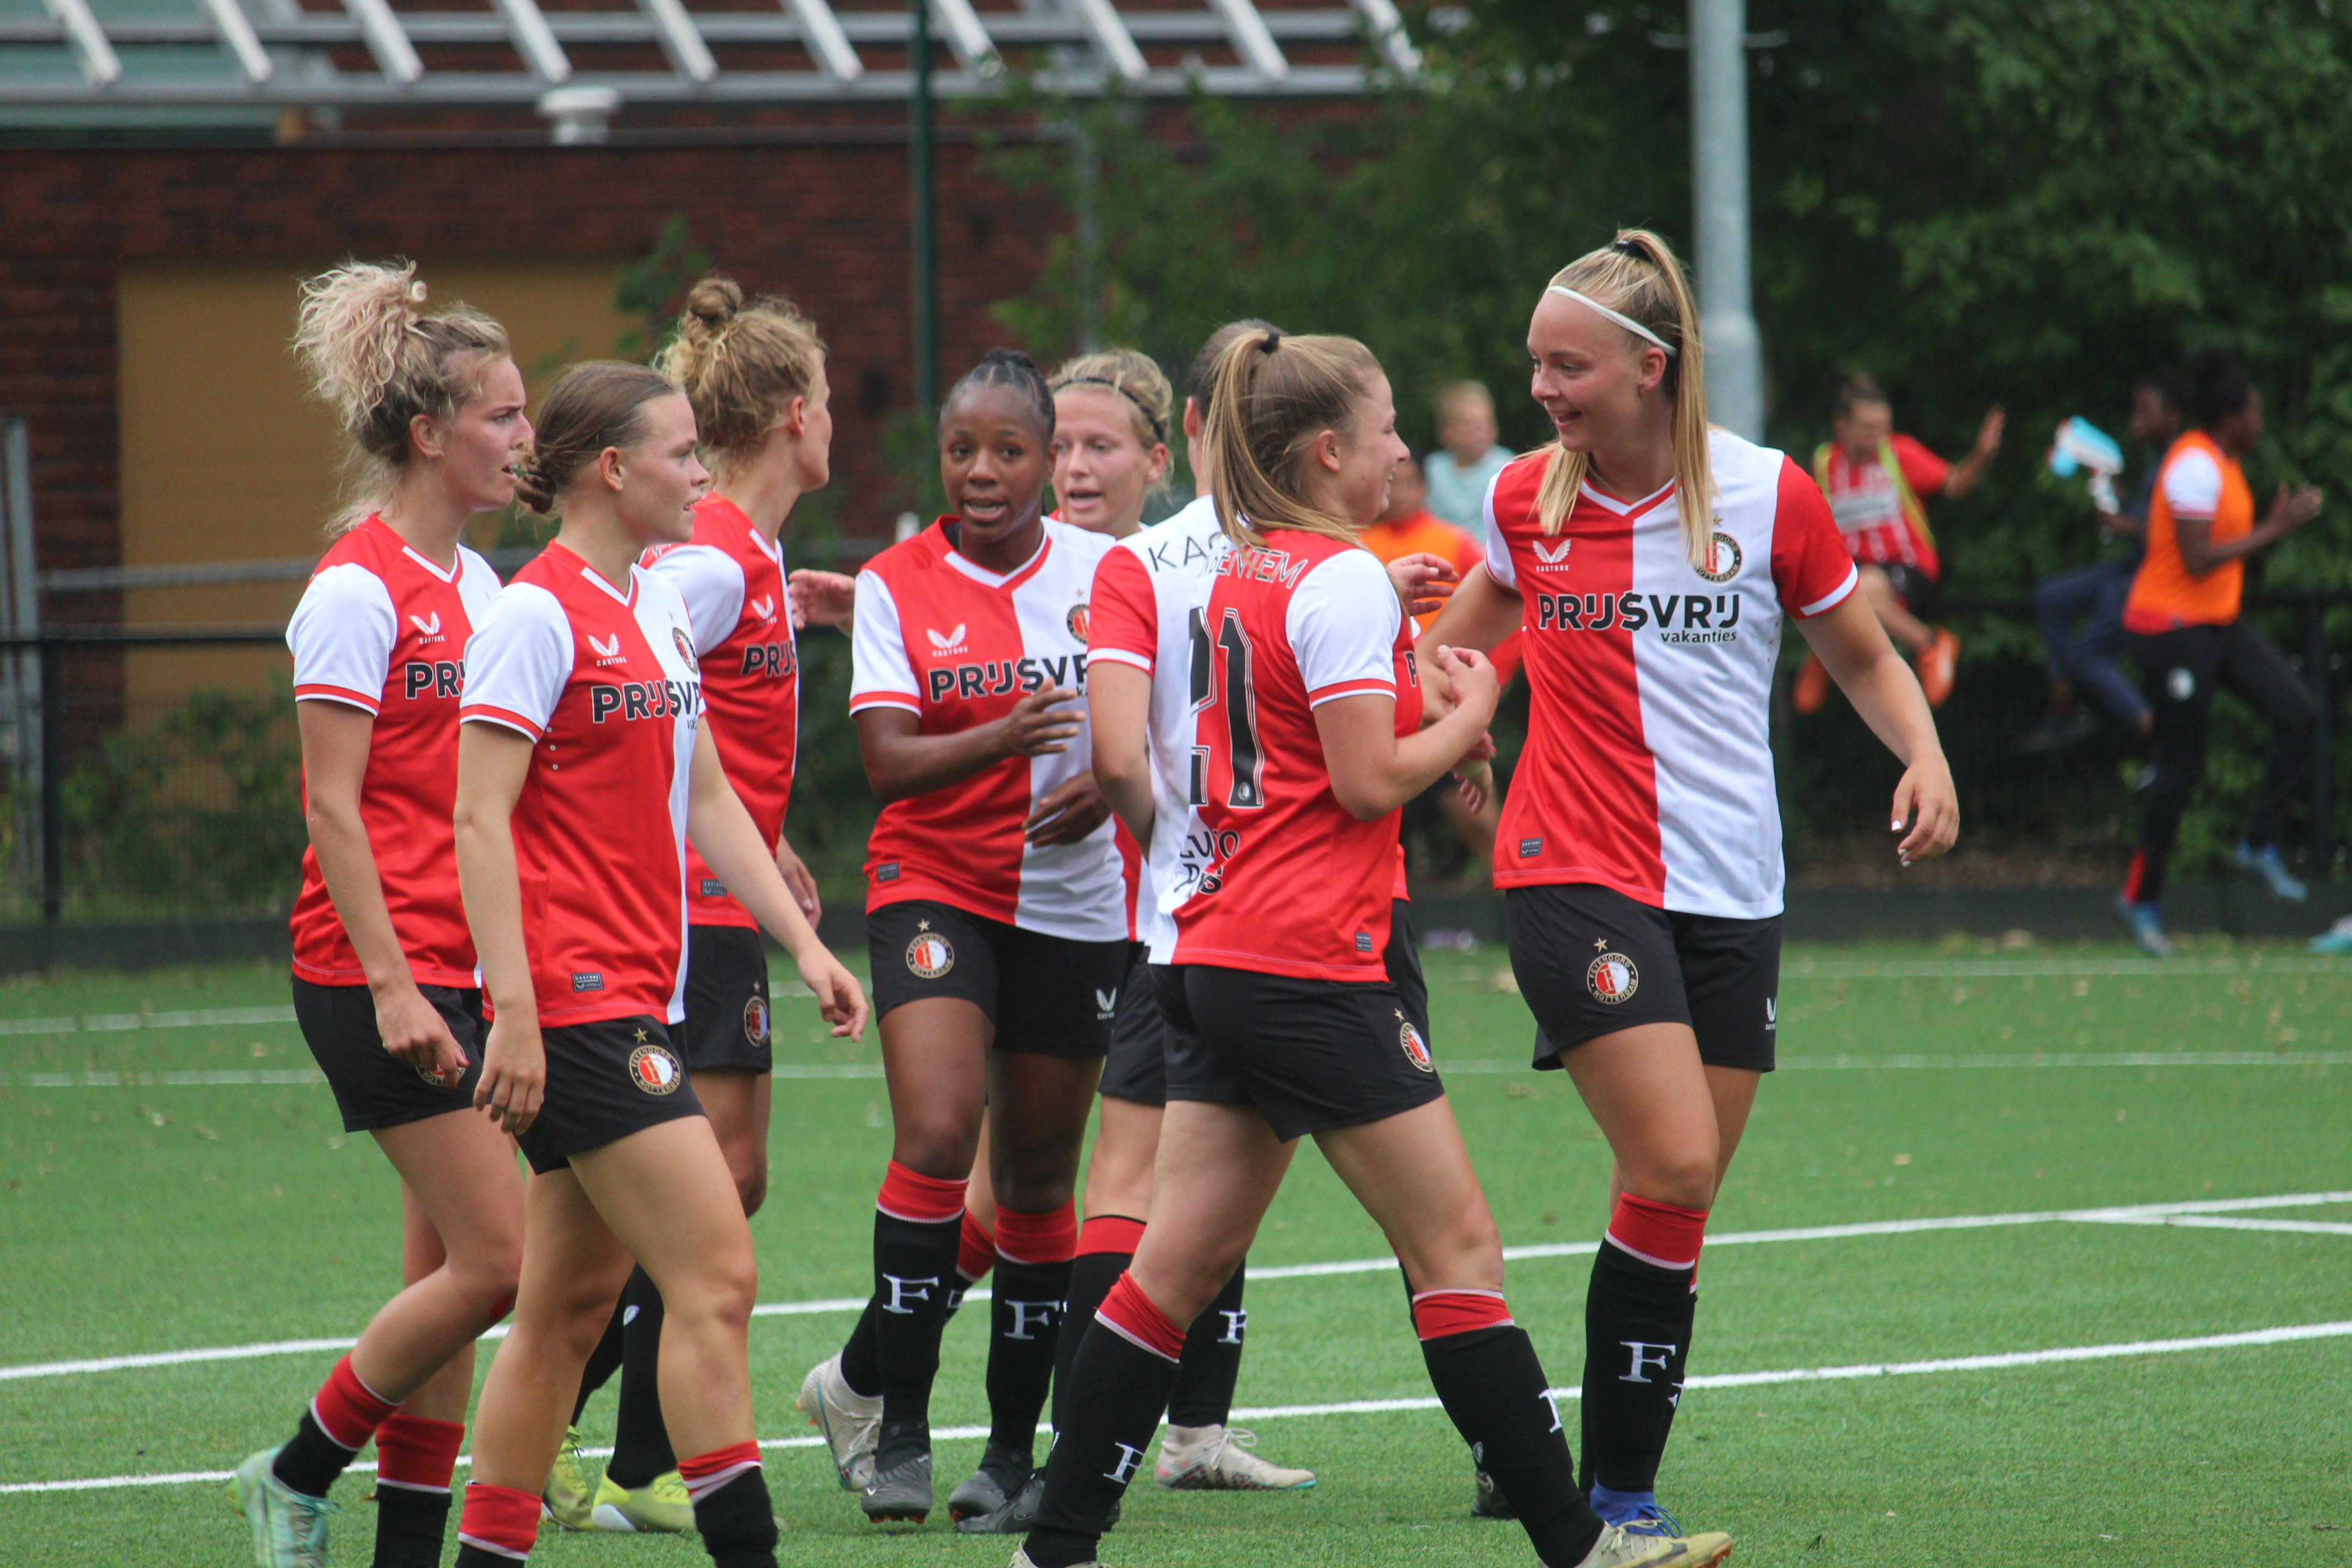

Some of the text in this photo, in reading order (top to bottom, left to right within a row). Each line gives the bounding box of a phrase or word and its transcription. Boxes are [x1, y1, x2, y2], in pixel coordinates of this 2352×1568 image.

[1536, 564, 1569, 573] CASTORE
[1661, 629, 1738, 644] vakanties
[883, 1273, 940, 1314] F
[1003, 1299, 1060, 1340] F
[1618, 1341, 1676, 1384] F
